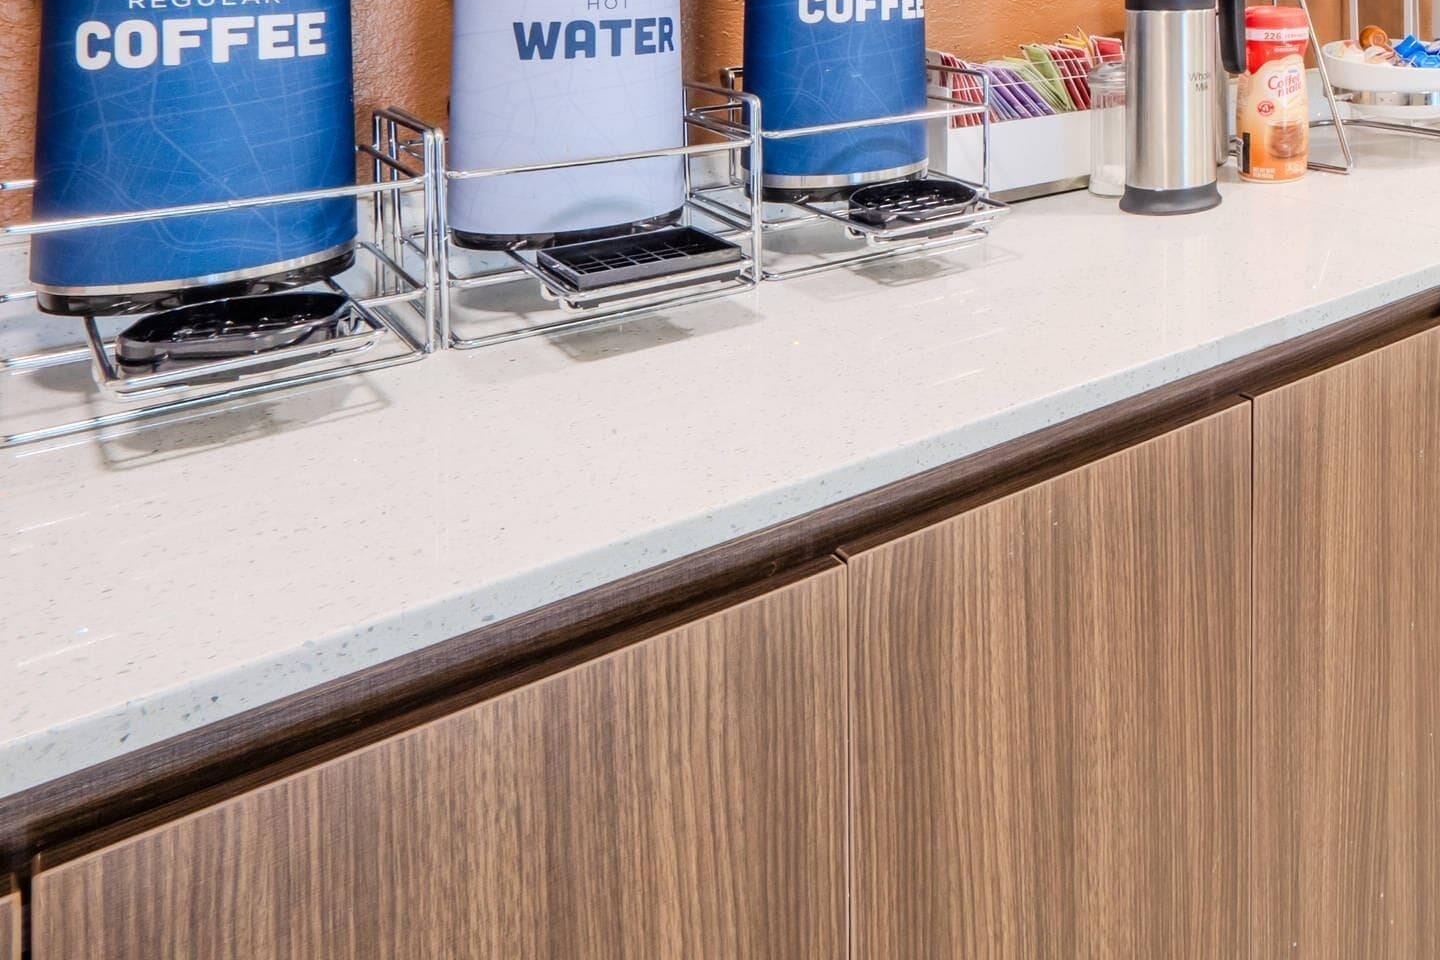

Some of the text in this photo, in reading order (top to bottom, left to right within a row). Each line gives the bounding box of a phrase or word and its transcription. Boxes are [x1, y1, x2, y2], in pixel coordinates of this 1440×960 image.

[76, 11, 327, 71] COFFEE
[513, 16, 674, 61] WATER
[1264, 32, 1282, 40] 226
